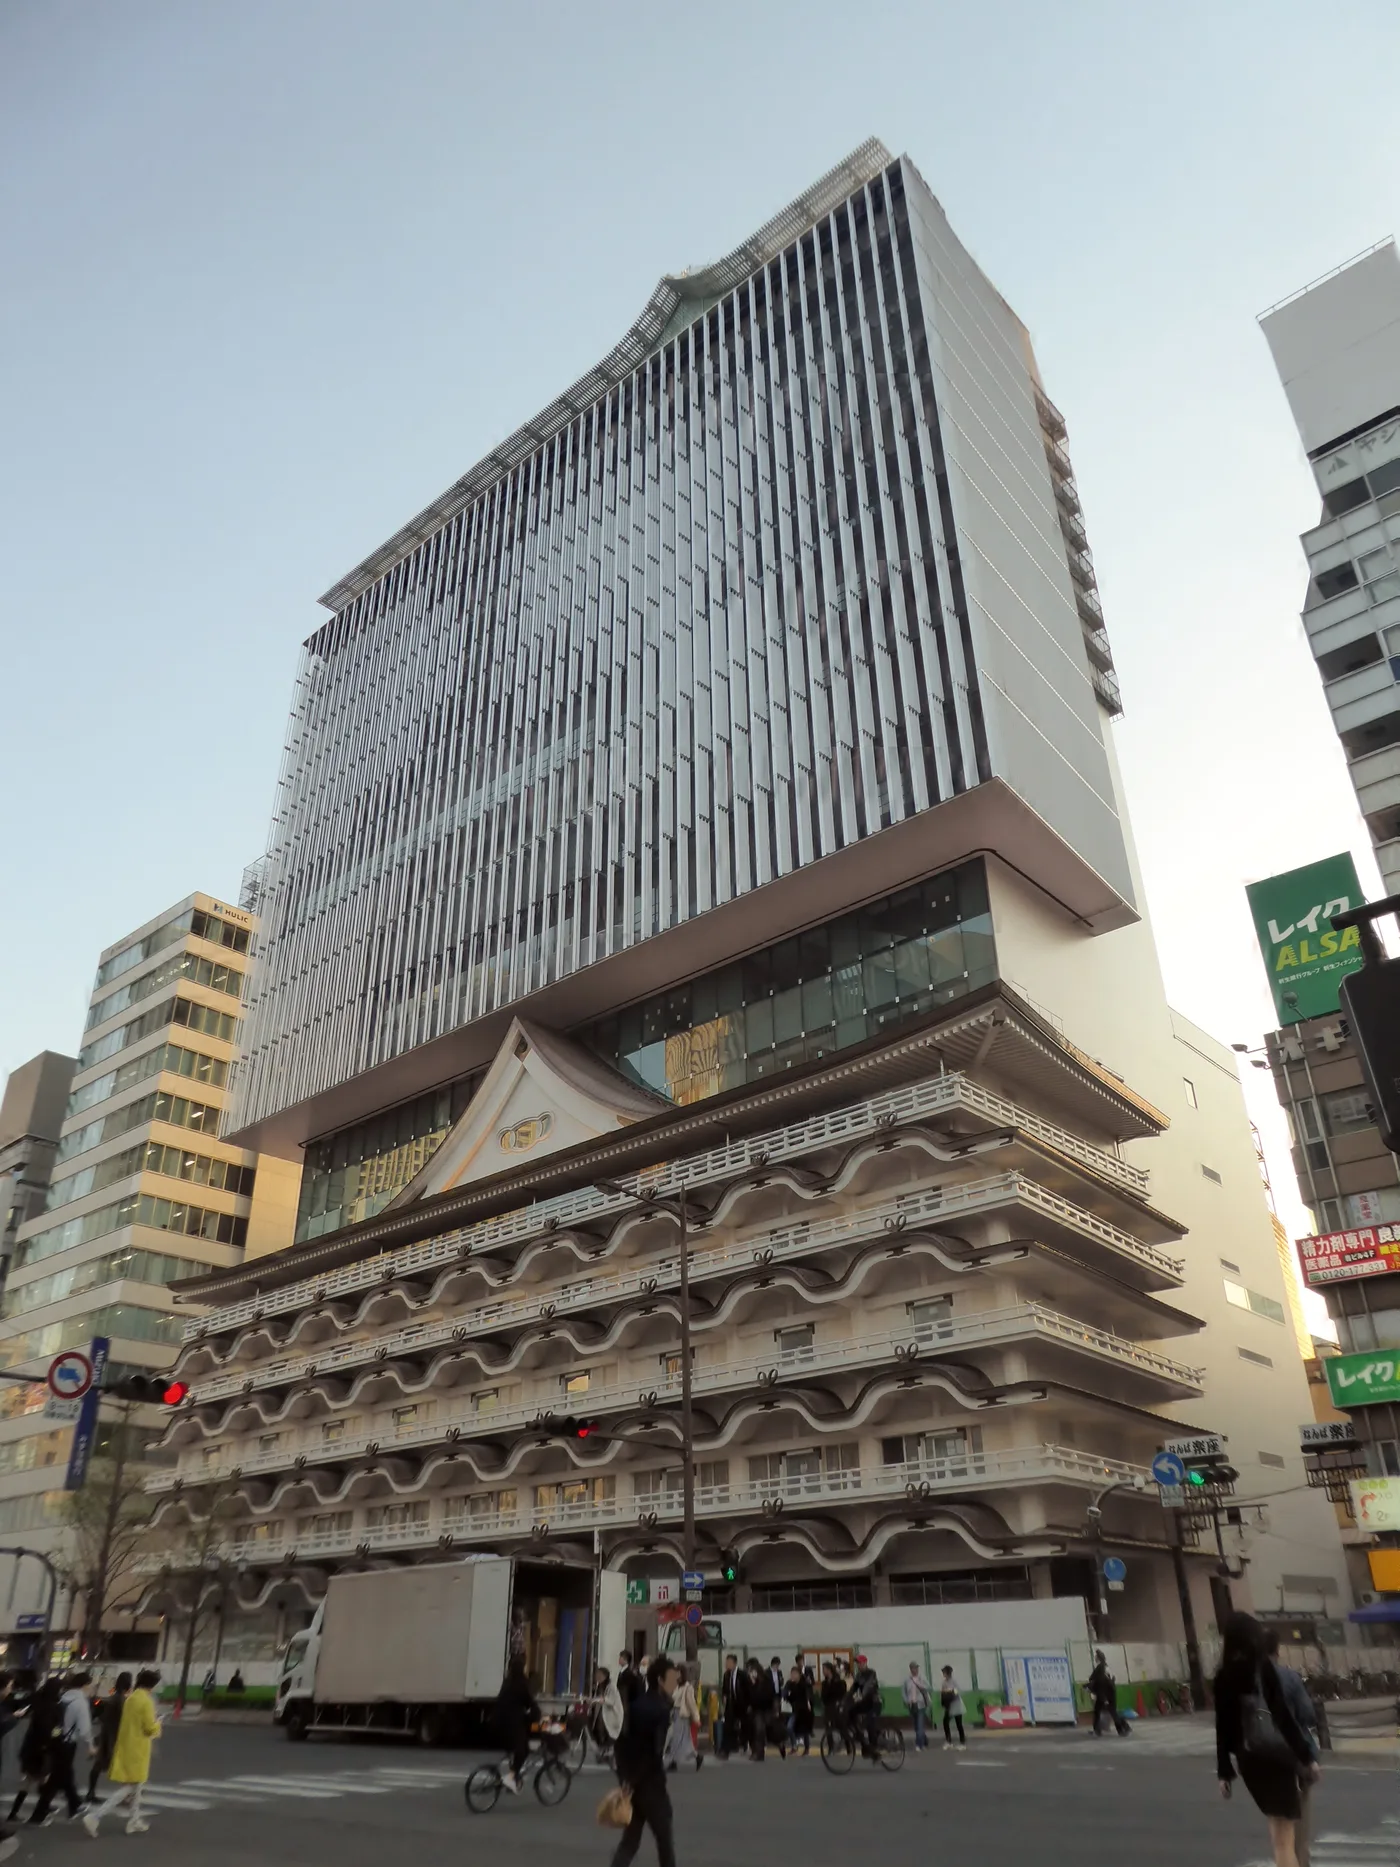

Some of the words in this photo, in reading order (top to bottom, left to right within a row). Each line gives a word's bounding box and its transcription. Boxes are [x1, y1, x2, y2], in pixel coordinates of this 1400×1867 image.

[225, 909, 249, 923] HULIC
[1267, 896, 1350, 944] レイク
[1276, 924, 1360, 971] ALSA
[1301, 1229, 1375, 1257] 精力剤専門
[1305, 1254, 1342, 1271] 医薬品
[1336, 1361, 1394, 1388] レイク
